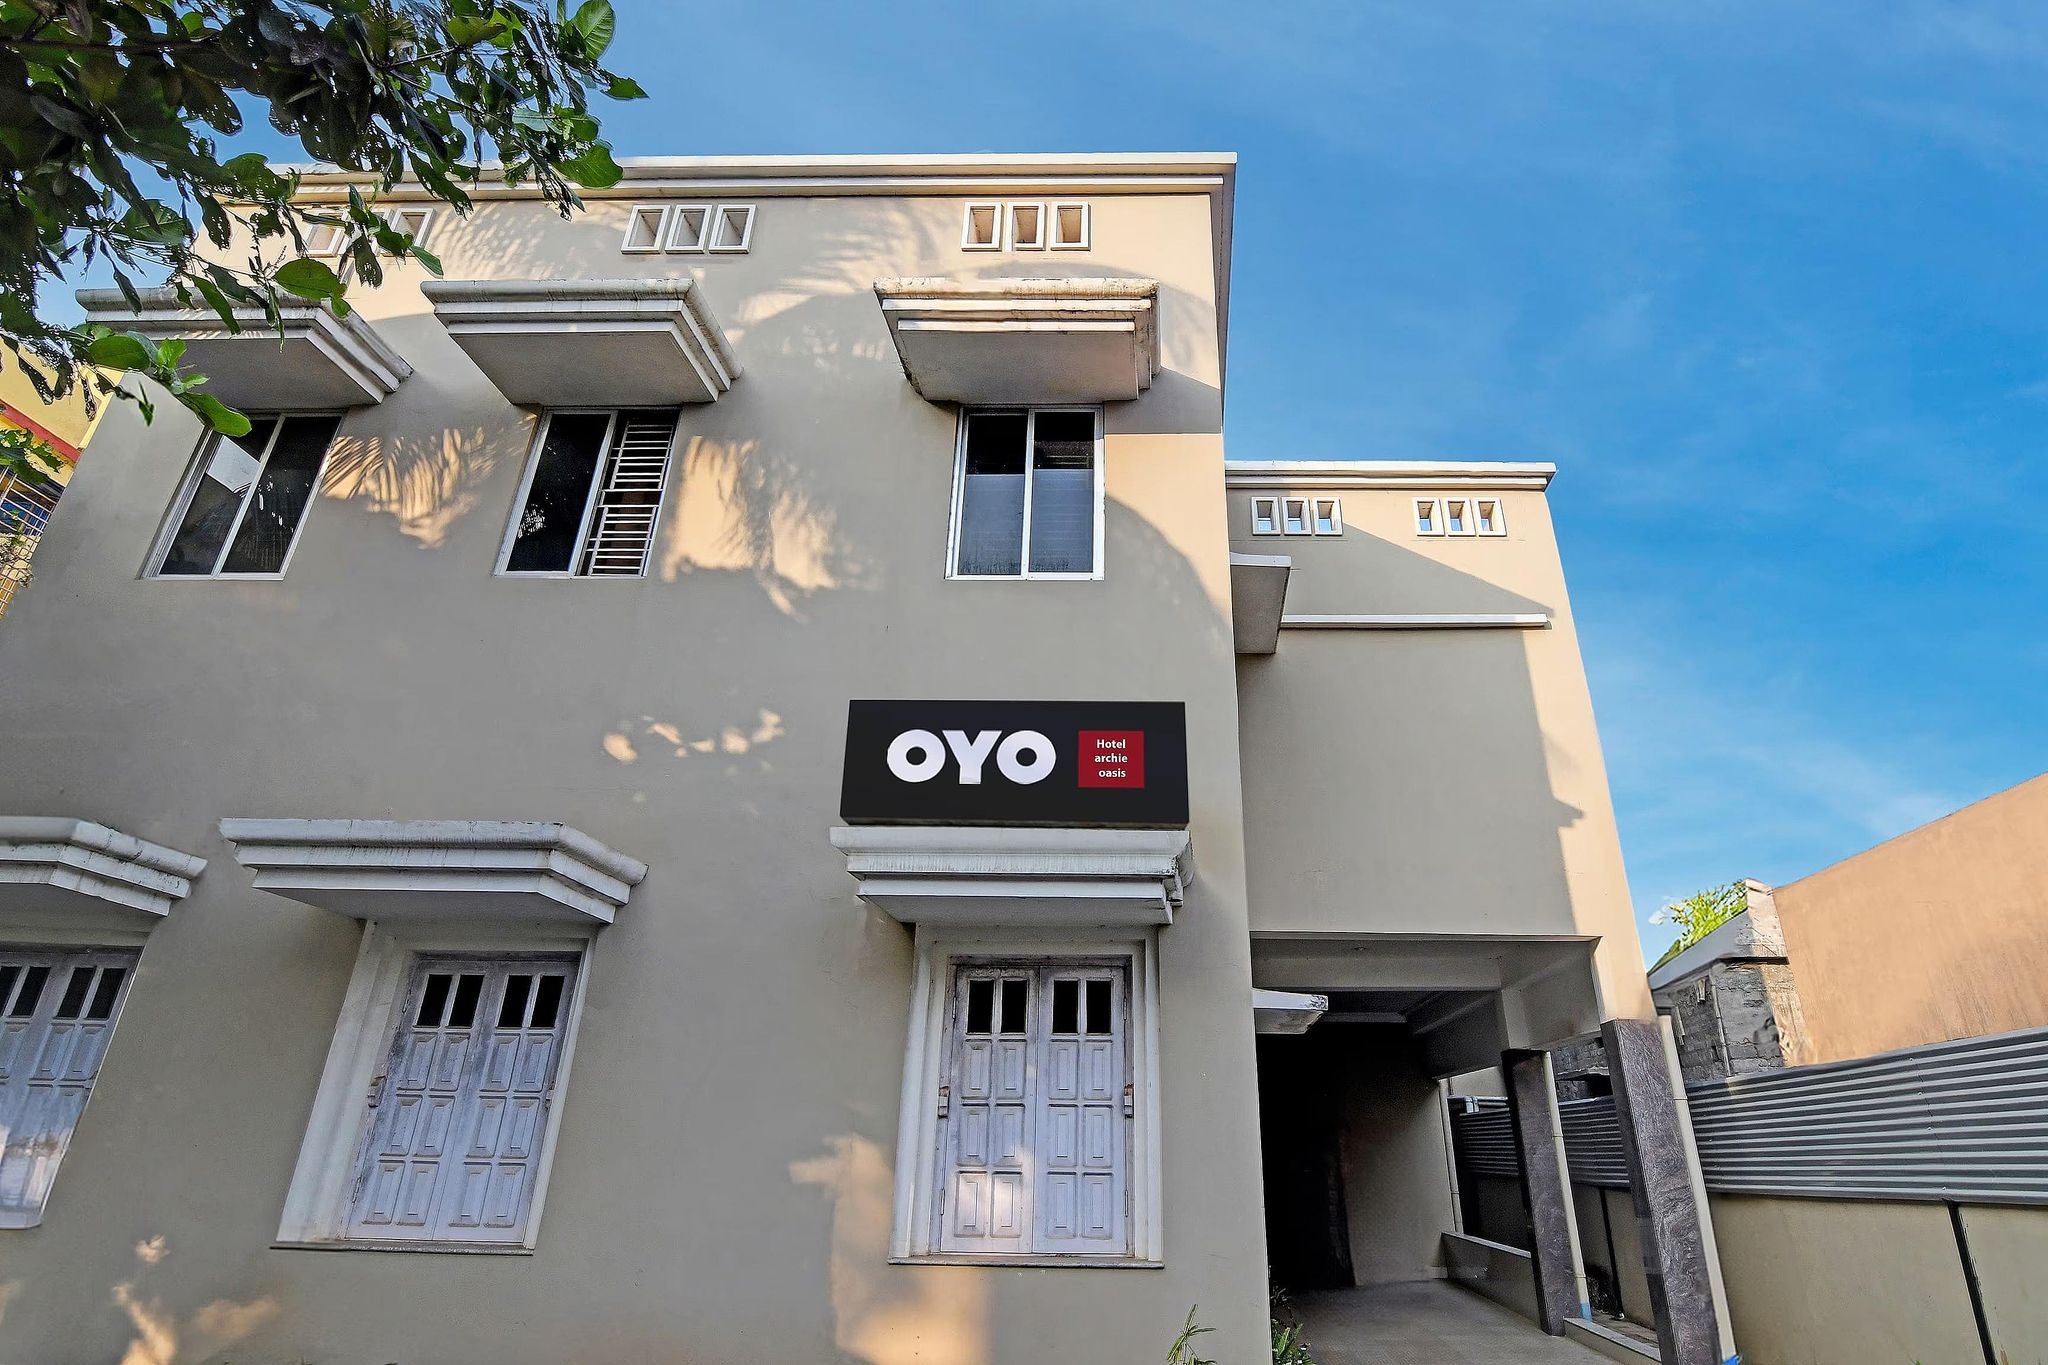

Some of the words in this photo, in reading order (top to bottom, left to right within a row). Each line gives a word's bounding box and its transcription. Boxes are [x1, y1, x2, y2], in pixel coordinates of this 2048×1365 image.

[1096, 738, 1126, 749] Hotel
[886, 729, 1057, 785] OYO
[1094, 752, 1128, 763] archie
[1098, 767, 1127, 778] oasis
